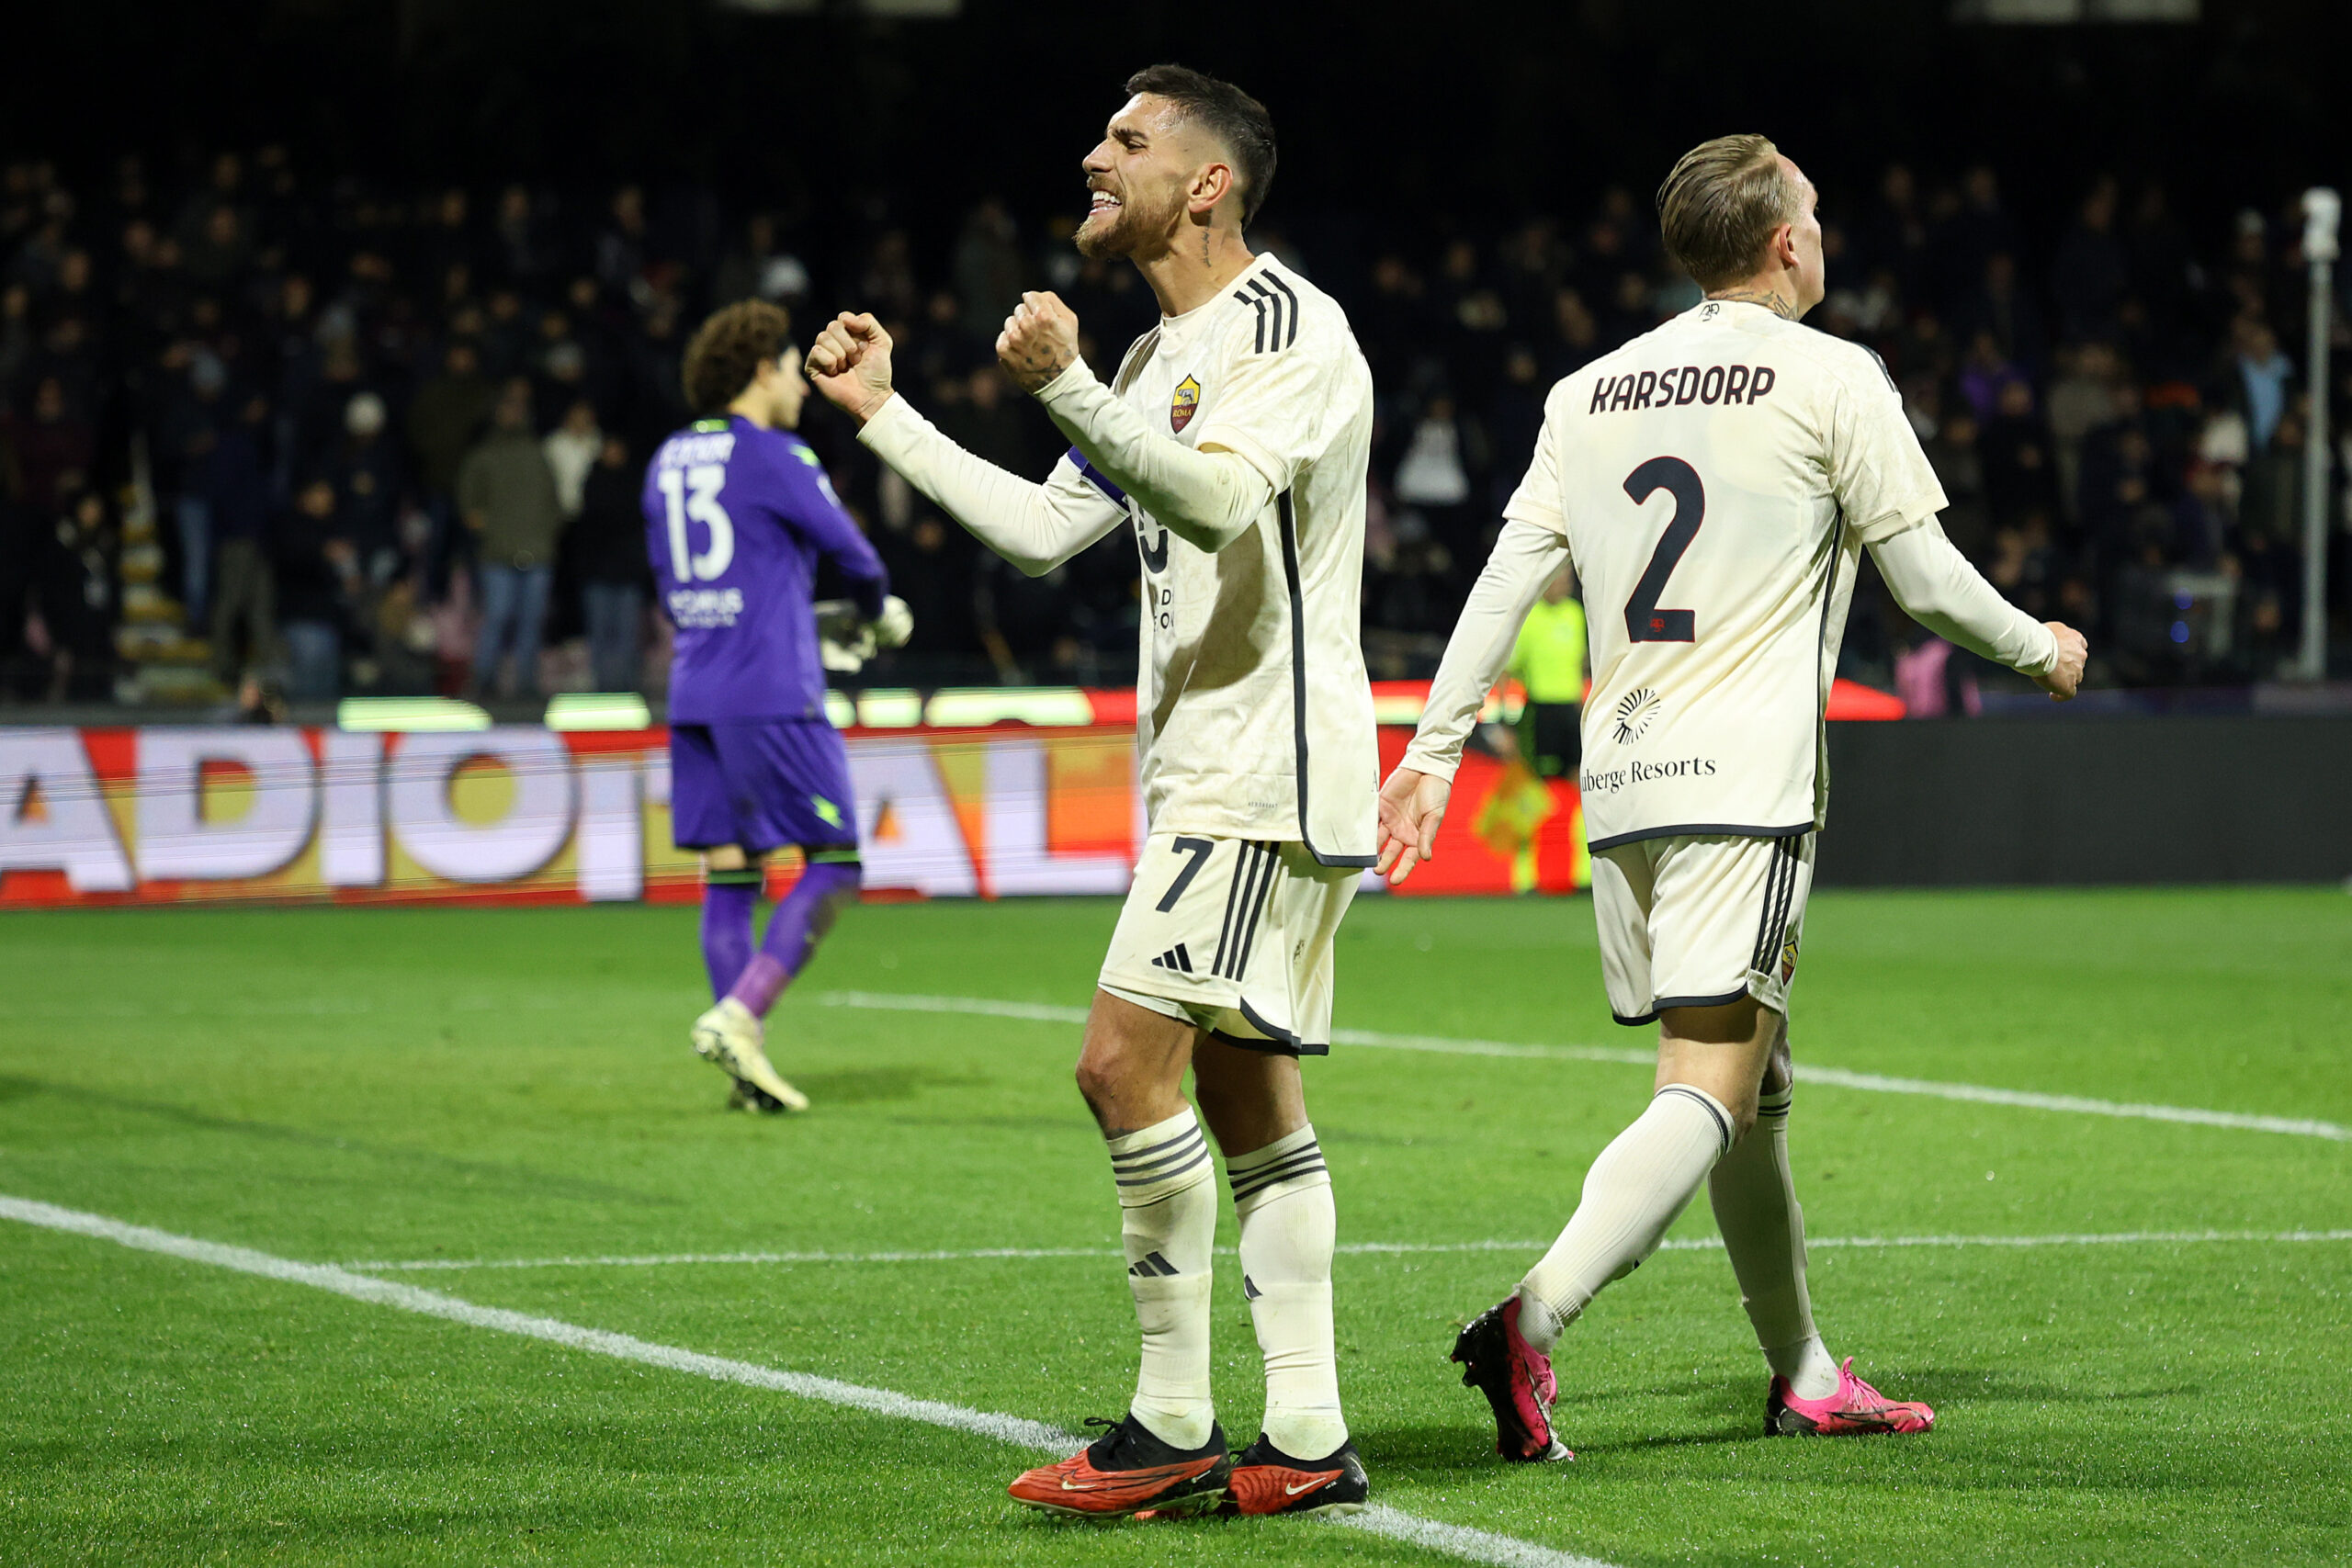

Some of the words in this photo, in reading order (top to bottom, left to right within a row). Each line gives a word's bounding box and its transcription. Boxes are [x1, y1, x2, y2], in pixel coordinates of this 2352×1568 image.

[1172, 409, 1192, 418] ROMA
[1589, 365, 1776, 414] KARSDORP
[657, 464, 735, 583] 13
[1623, 456, 1705, 643] 2
[1631, 757, 1716, 783] Resorts
[1155, 836, 1214, 913] 7
